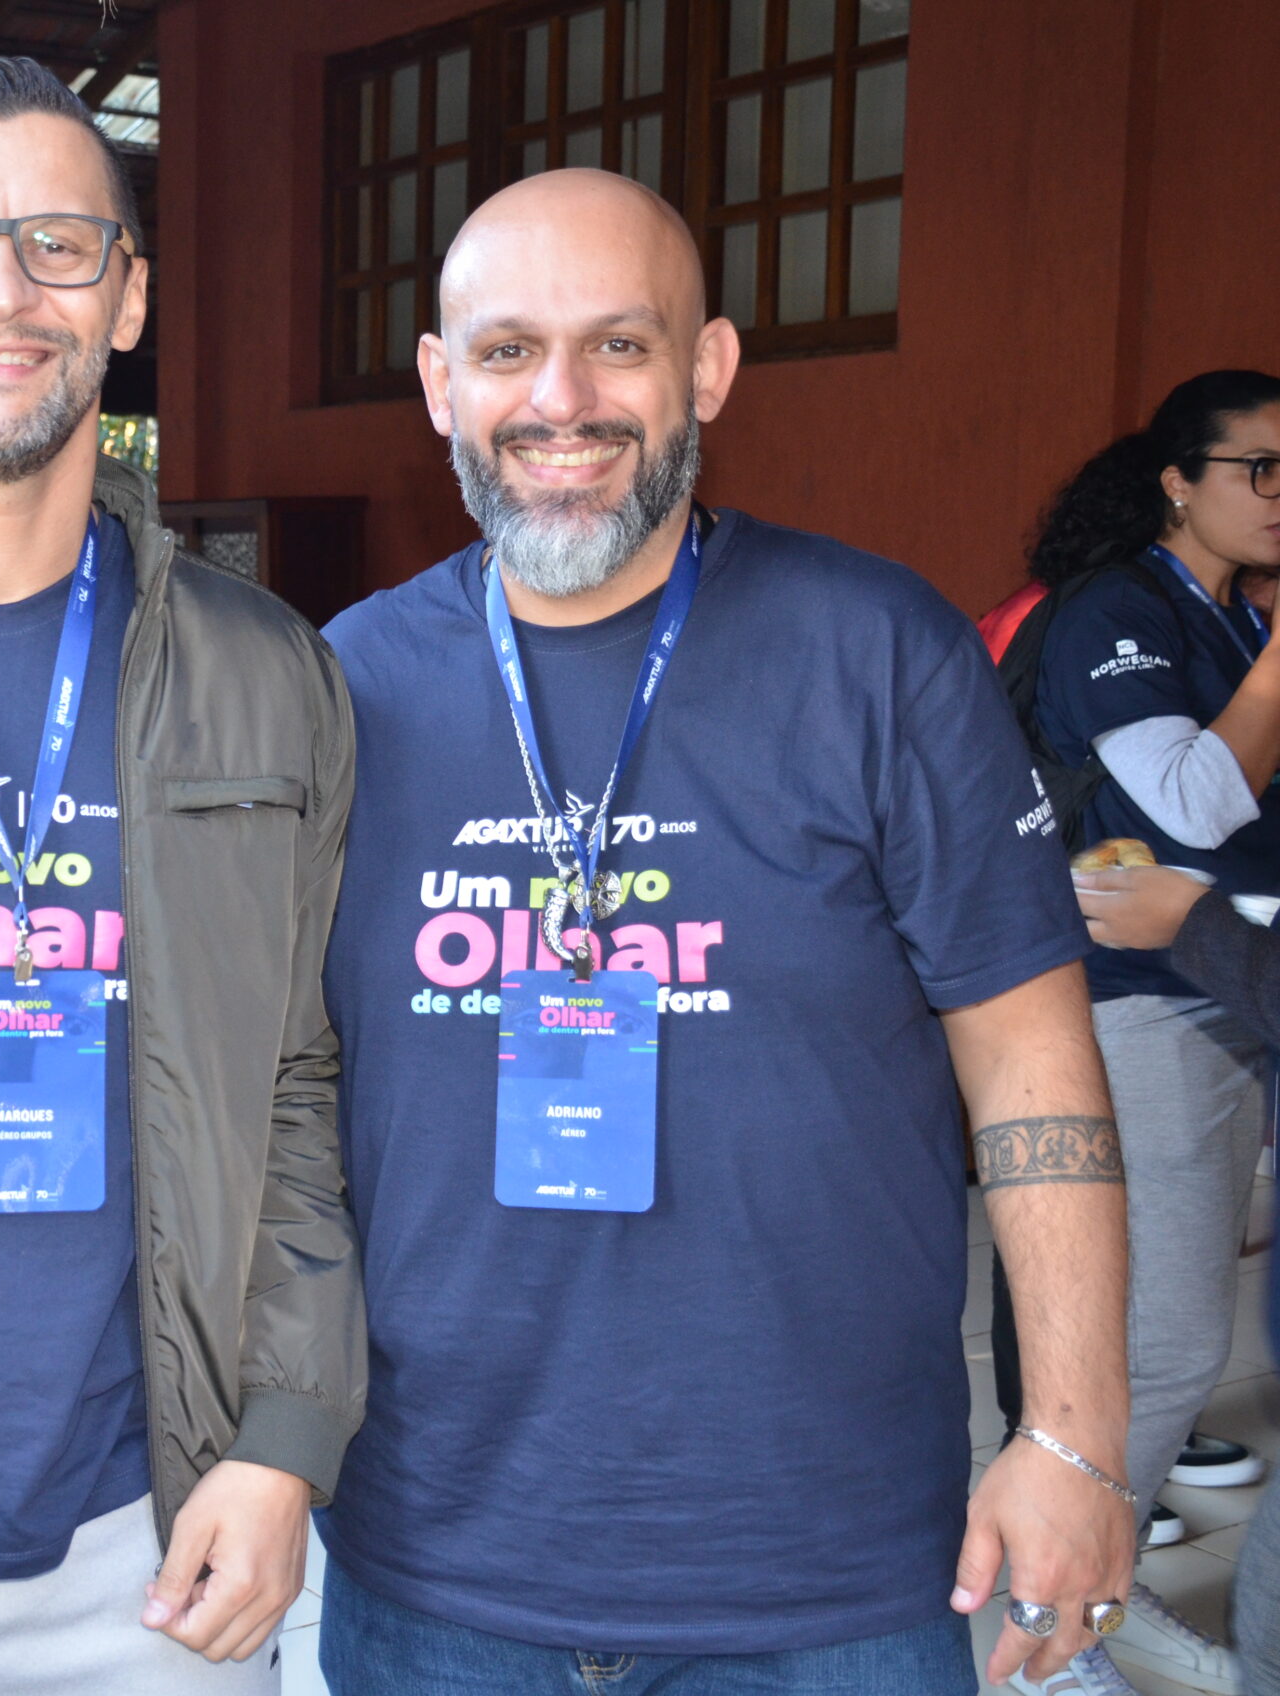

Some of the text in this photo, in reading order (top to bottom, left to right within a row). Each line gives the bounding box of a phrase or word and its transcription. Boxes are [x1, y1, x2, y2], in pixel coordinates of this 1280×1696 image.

[661, 631, 672, 648] 70
[1090, 654, 1171, 680] NORWEGIAN
[80, 802, 118, 819] anos
[611, 814, 656, 845] 70
[659, 819, 698, 834] anos
[419, 870, 512, 909] Um
[414, 908, 724, 988] Olhar
[15, 1000, 52, 1010] novo
[410, 988, 452, 1015] de
[656, 985, 731, 1014] fora
[539, 995, 604, 1008] Um novo
[539, 1006, 616, 1028] Olhar
[29, 1030, 44, 1039] pra
[45, 1030, 64, 1038] fora
[581, 1027, 596, 1036] pra
[597, 1027, 616, 1036] fora
[546, 1105, 602, 1120] ADRIANO
[21, 1131, 54, 1140] GRUPOS
[35, 1190, 49, 1200] 70
[583, 1187, 597, 1197] 70
